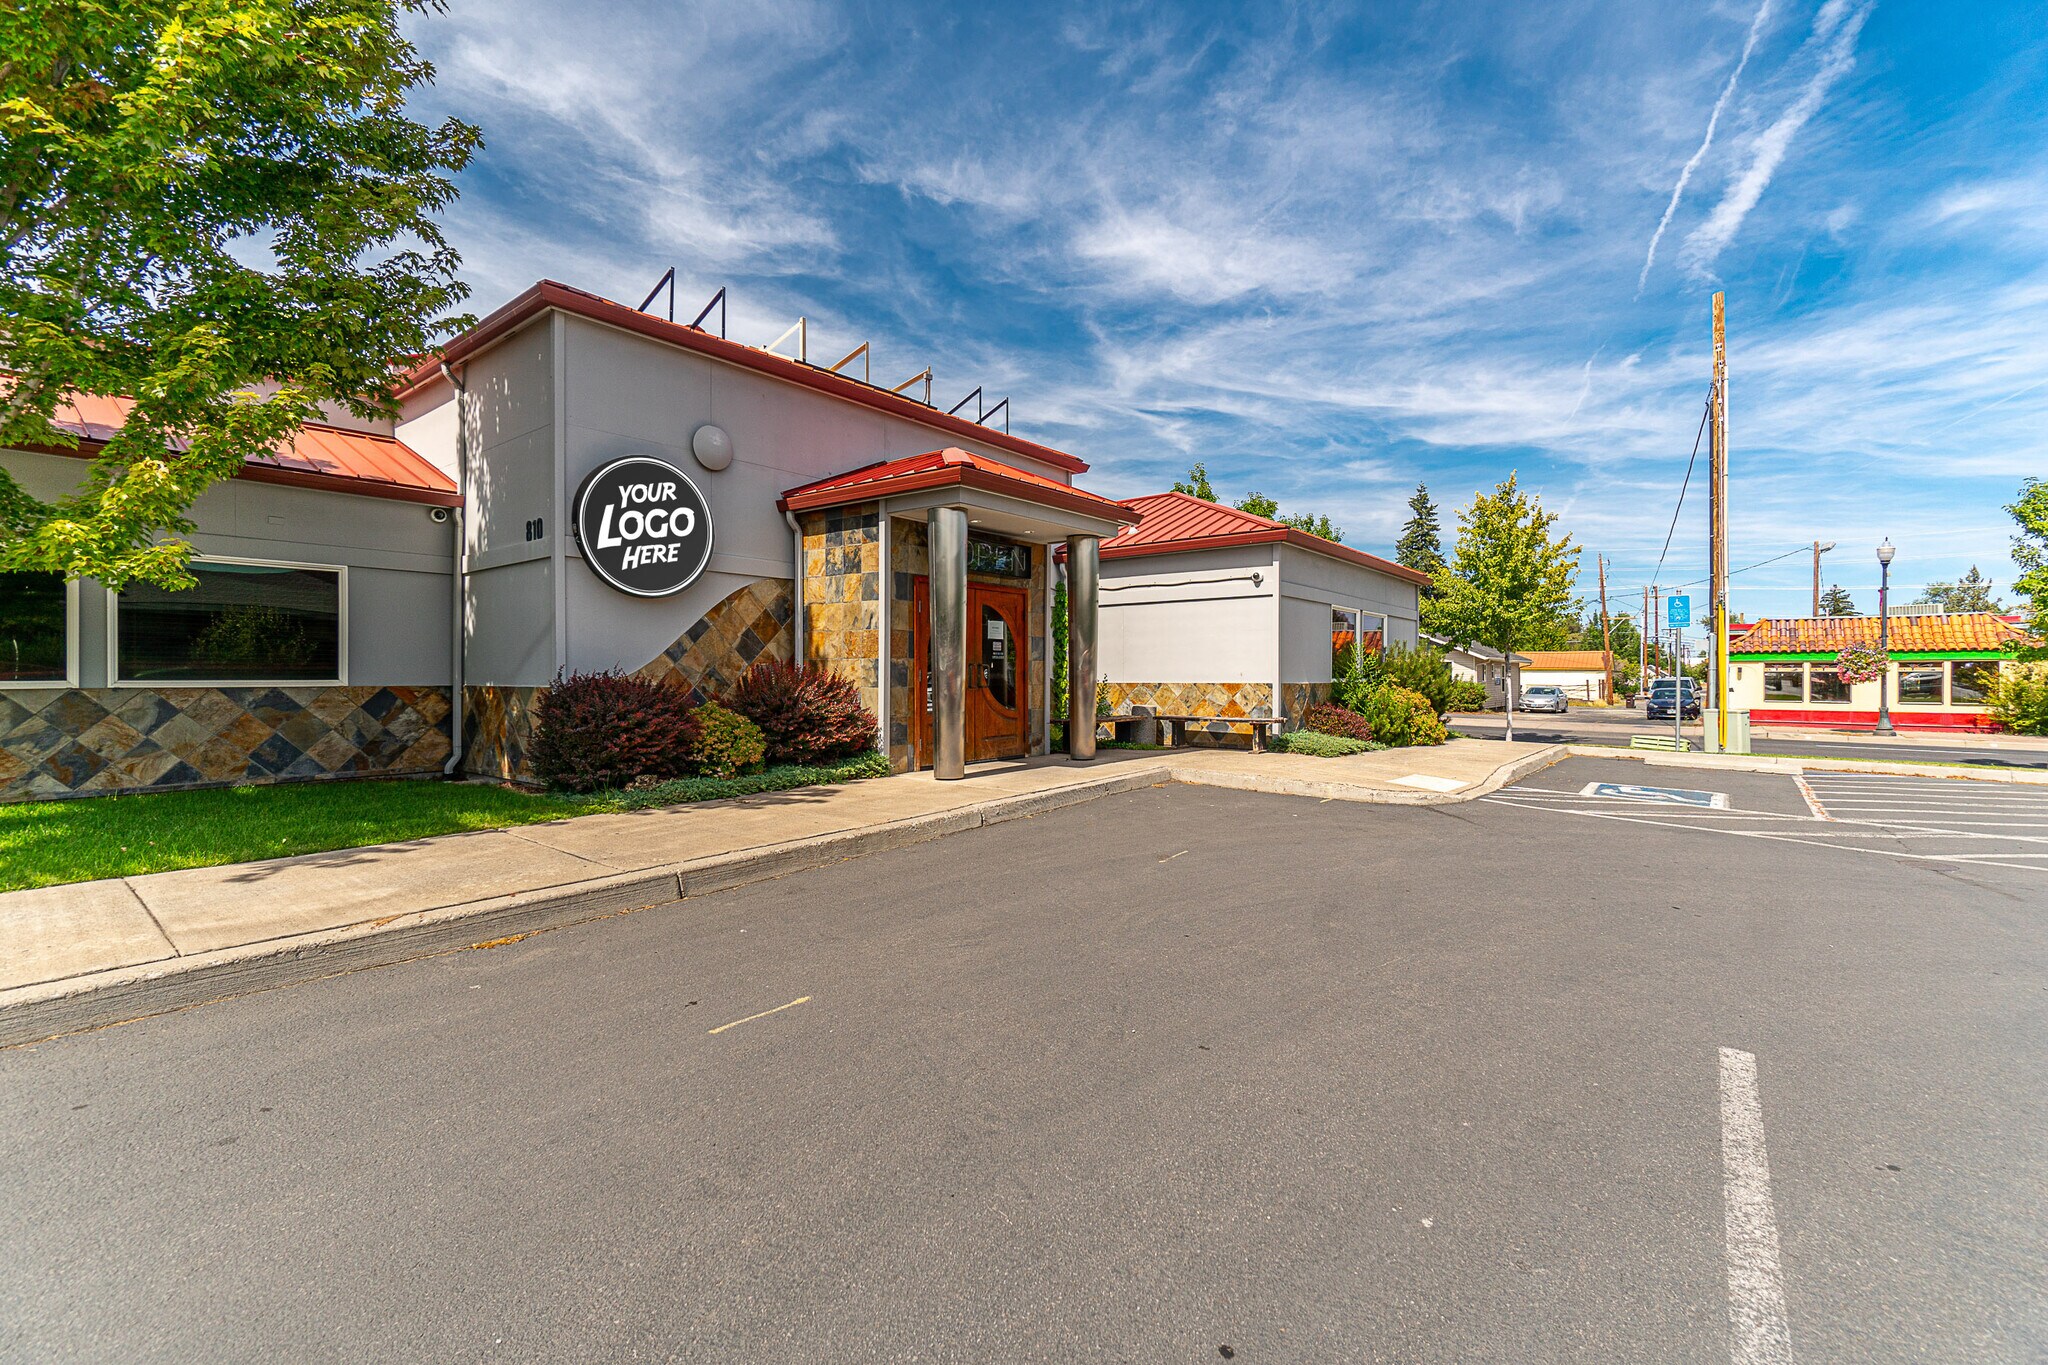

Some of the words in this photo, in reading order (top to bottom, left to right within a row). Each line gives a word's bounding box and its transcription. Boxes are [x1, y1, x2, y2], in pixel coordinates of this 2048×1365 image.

[619, 482, 677, 509] YOUR
[526, 517, 544, 542] 810
[597, 503, 695, 550] LOGO
[621, 543, 681, 570] HERE
